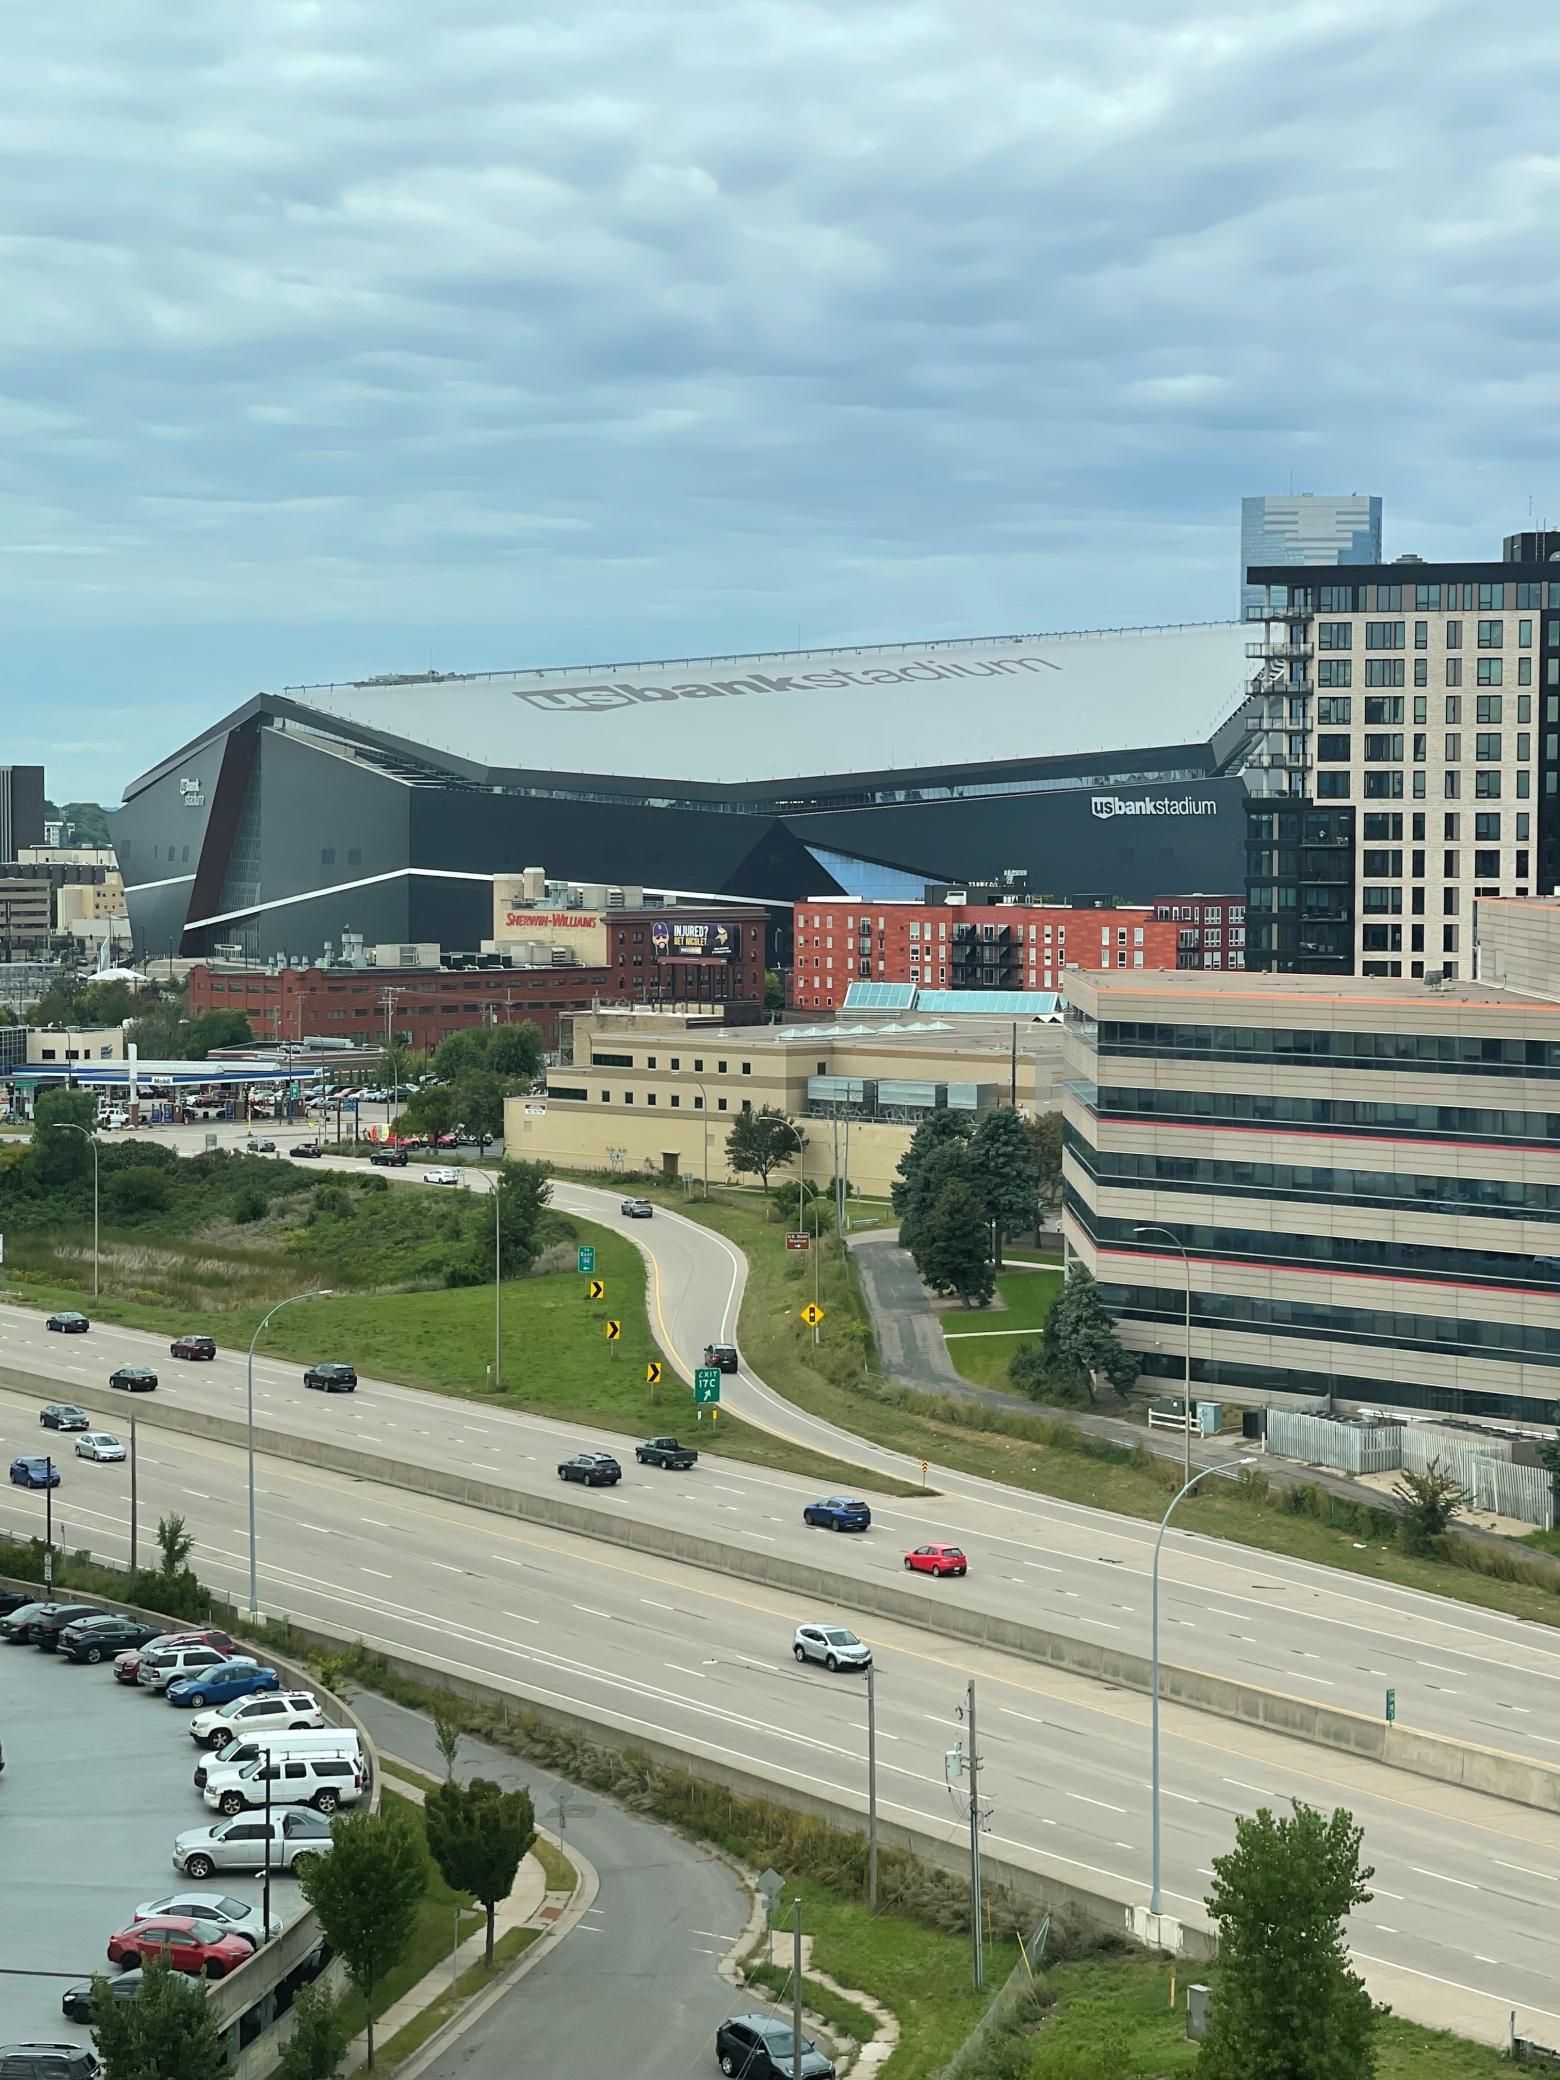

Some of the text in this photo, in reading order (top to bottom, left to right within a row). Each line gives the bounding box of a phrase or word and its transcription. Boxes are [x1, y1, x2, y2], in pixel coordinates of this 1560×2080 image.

[673, 925, 709, 938] INJURED?
[673, 936, 684, 946] GET
[698, 1370, 718, 1378] EXIT
[699, 1378, 716, 1388] 17C
